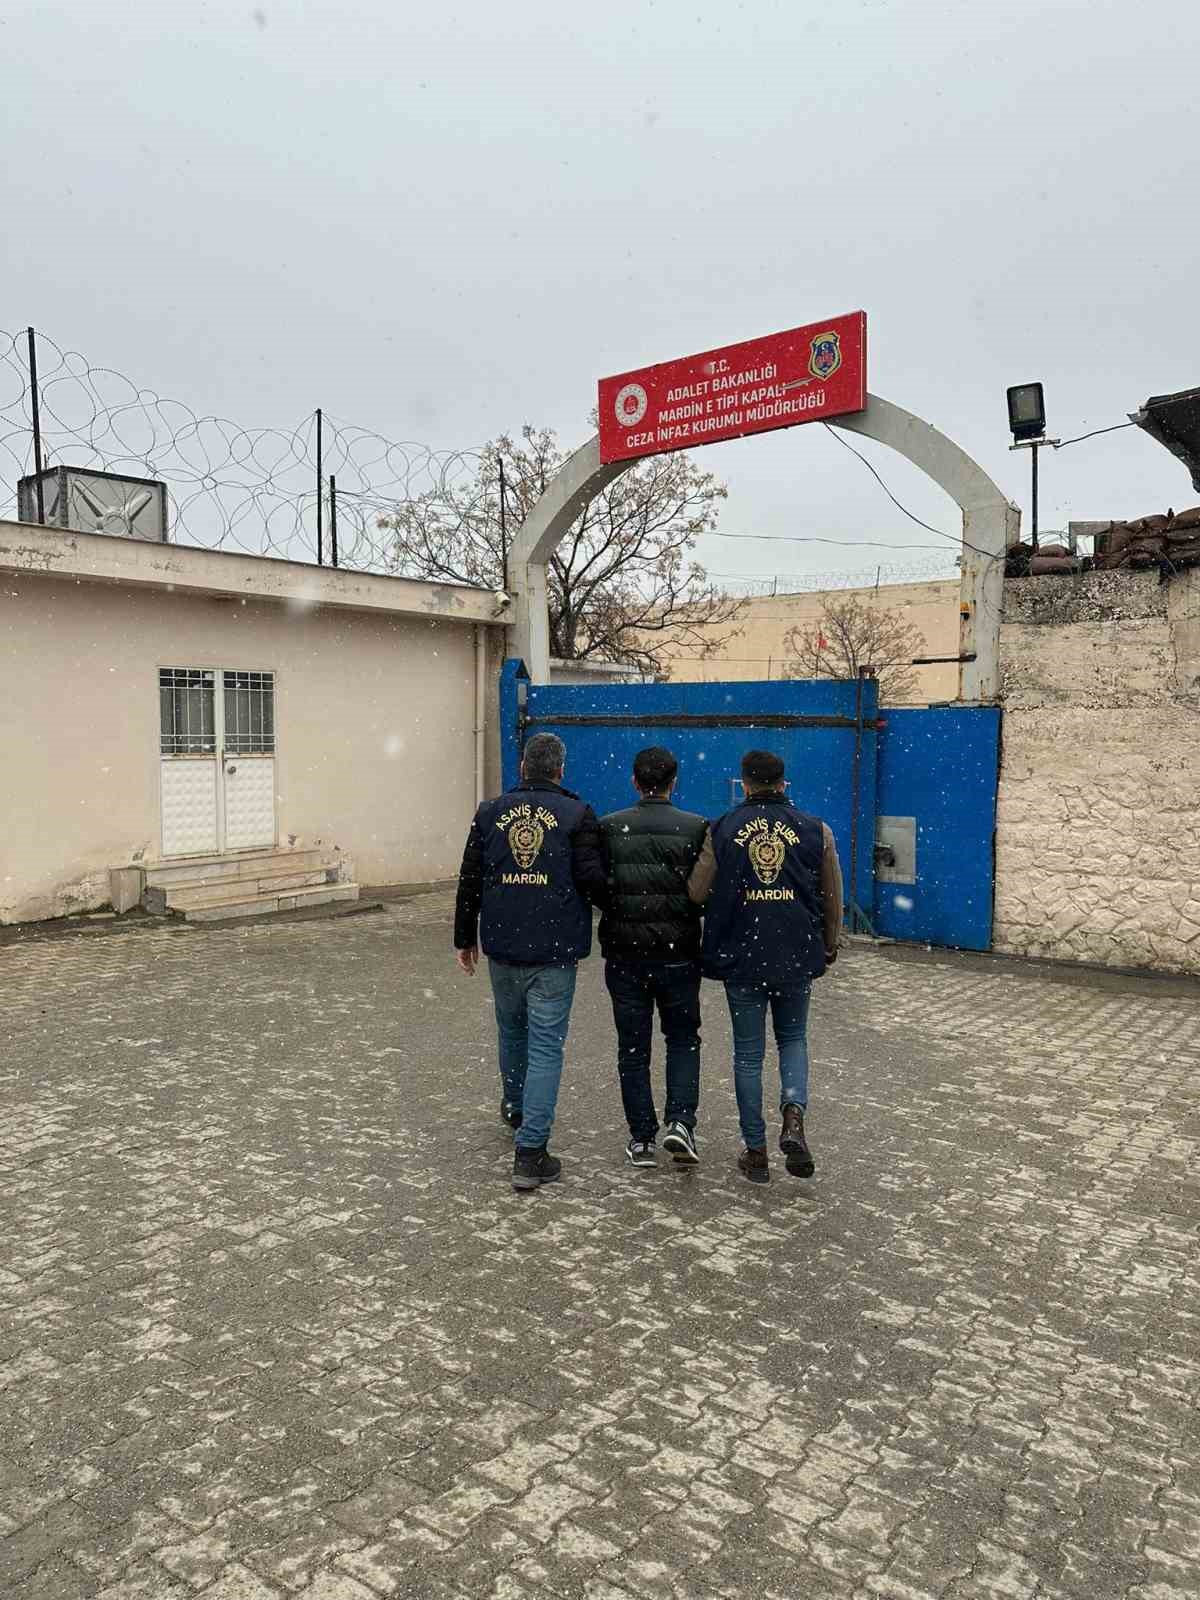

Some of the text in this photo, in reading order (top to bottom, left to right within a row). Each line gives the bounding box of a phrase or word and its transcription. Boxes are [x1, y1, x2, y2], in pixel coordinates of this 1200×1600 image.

[710, 359, 731, 375] T.C.
[666, 364, 777, 402] ADALET BAKANLIĞI
[626, 389, 826, 448] CEZA İNFAZ KURUMU MÜDÜRLÜĞÜ
[659, 383, 786, 424] MARDİN E TİPİ KAPALI
[496, 802, 558, 831] ASAYİŞ ŞUBE
[734, 816, 800, 847] ASAYİŞ ŞUBE
[502, 871, 548, 885] MARDİN
[745, 887, 794, 900] MARDİN
